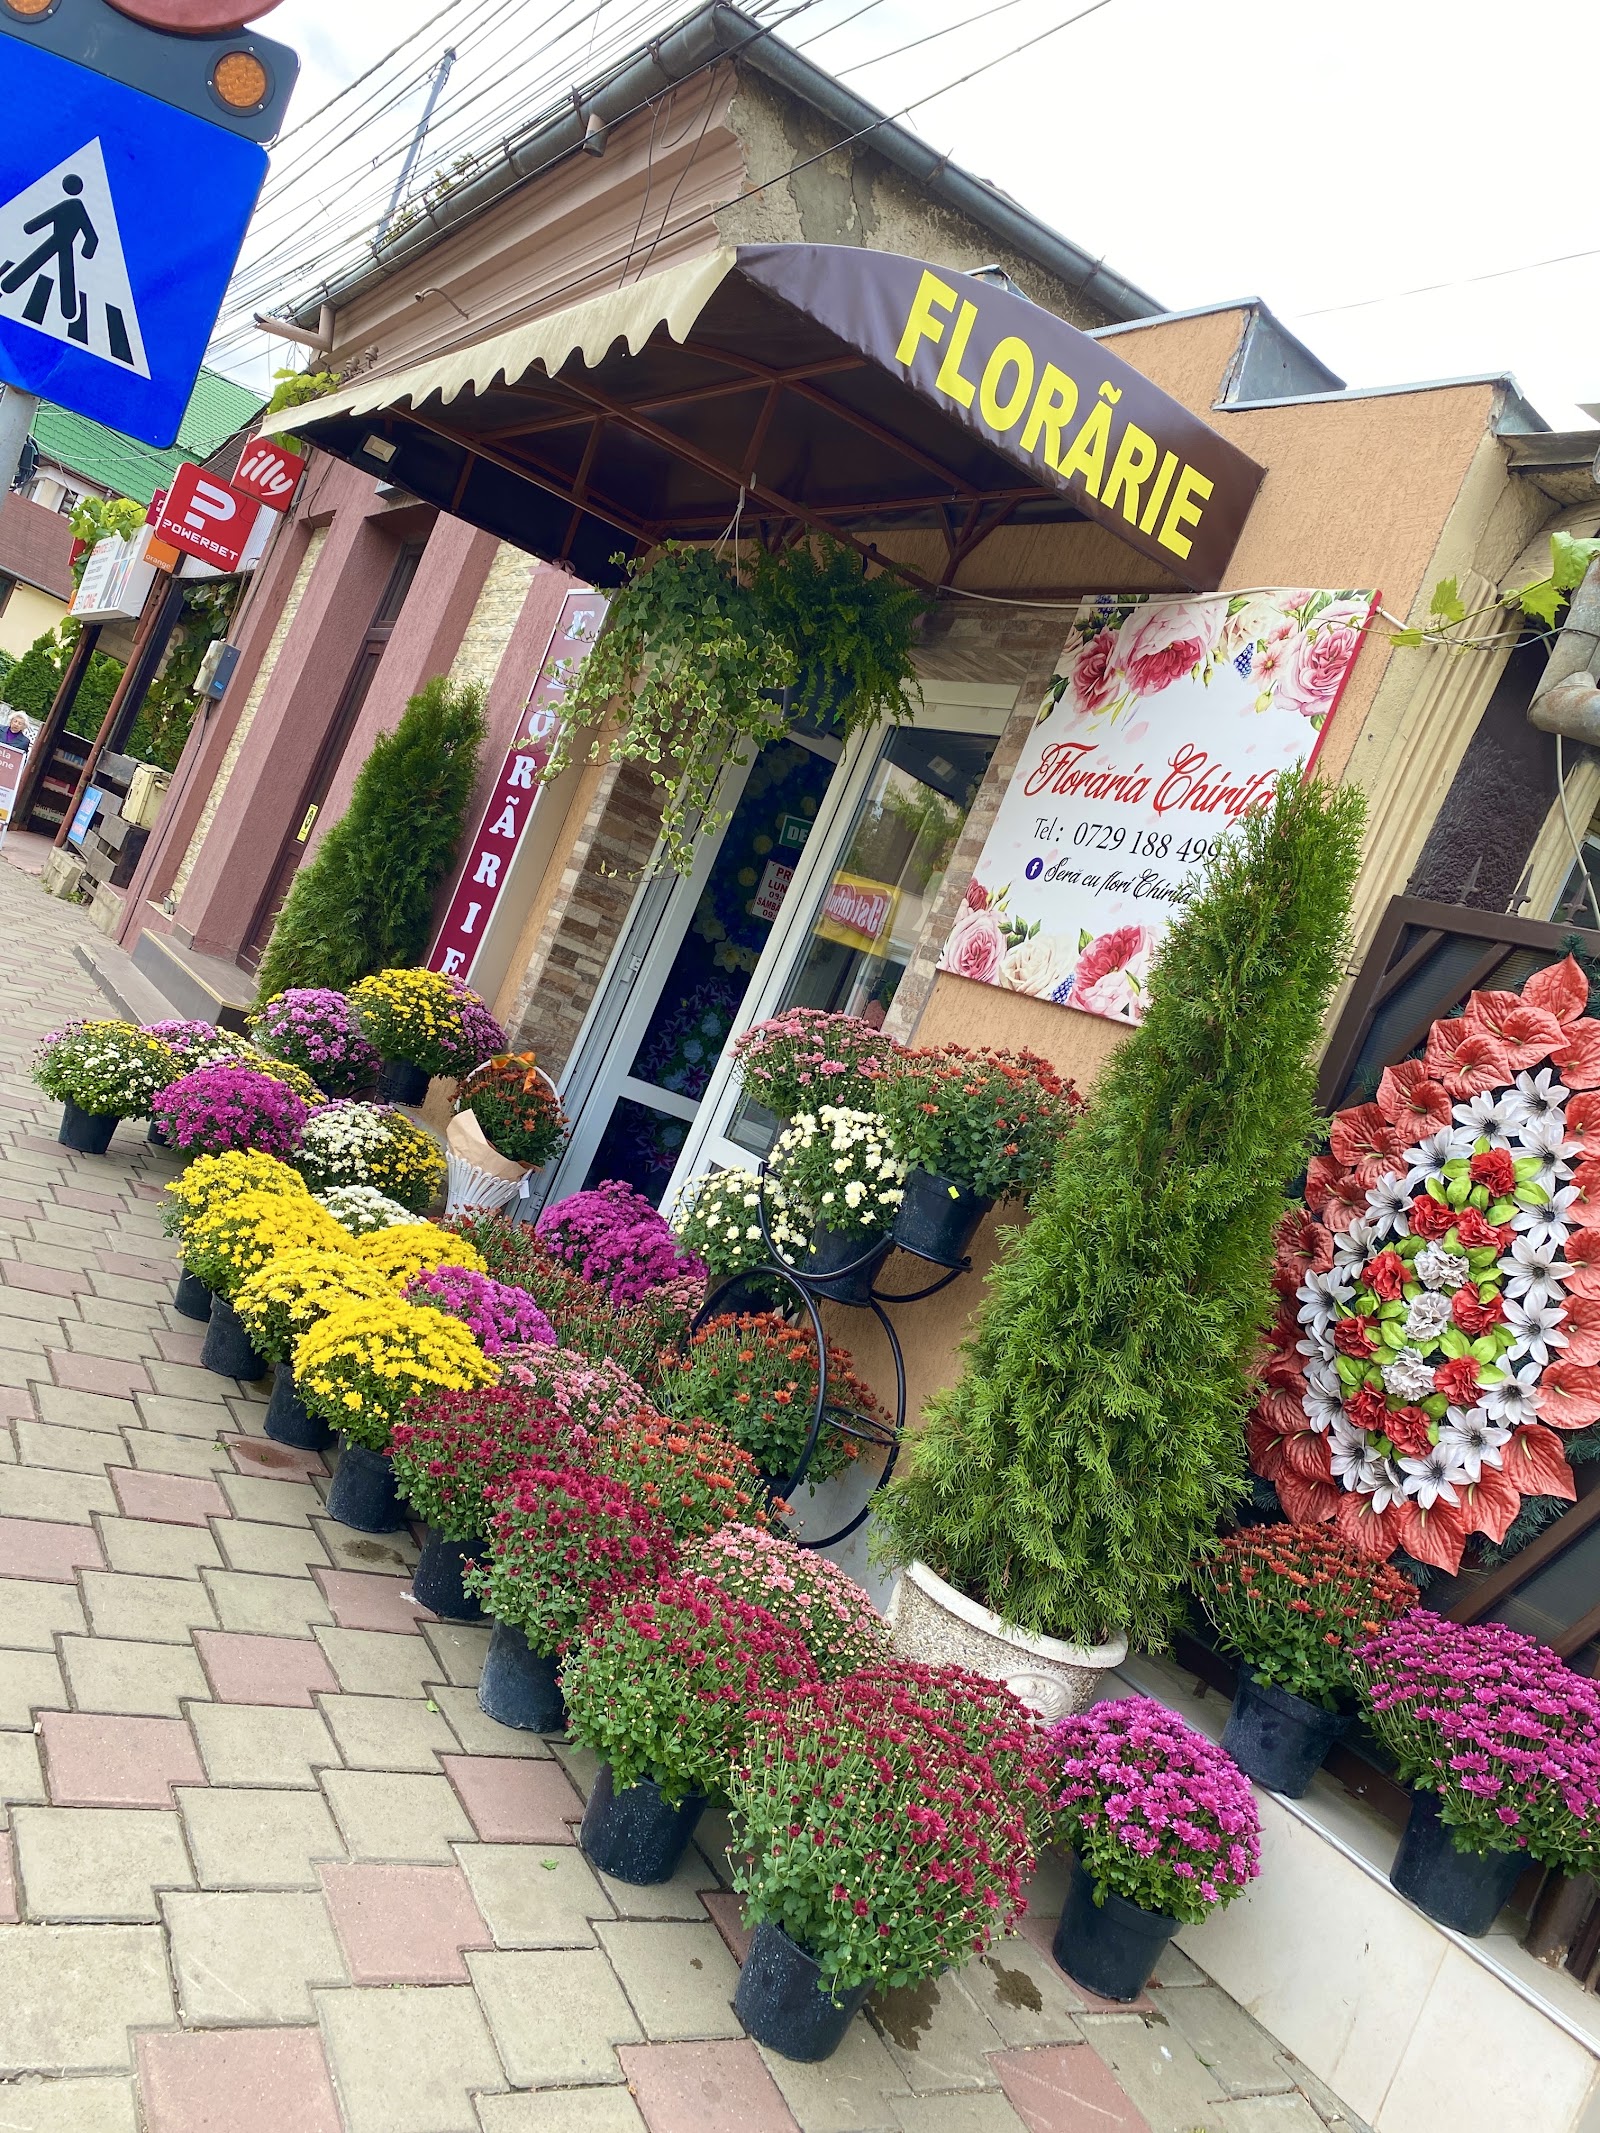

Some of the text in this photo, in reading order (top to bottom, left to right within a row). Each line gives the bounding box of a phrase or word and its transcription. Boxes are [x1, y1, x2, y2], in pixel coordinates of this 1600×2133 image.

[239, 450, 294, 496] illy
[162, 518, 239, 561] POWERBET
[145, 554, 171, 569] orange
[1023, 742, 1153, 804] Florăria
[1073, 821, 1127, 851] 0729
[1129, 830, 1173, 859] 188
[1176, 837, 1222, 866] 499
[775, 867, 794, 880] PR
[1082, 873, 1102, 888] cu
[1094, 870, 1137, 897] flori
